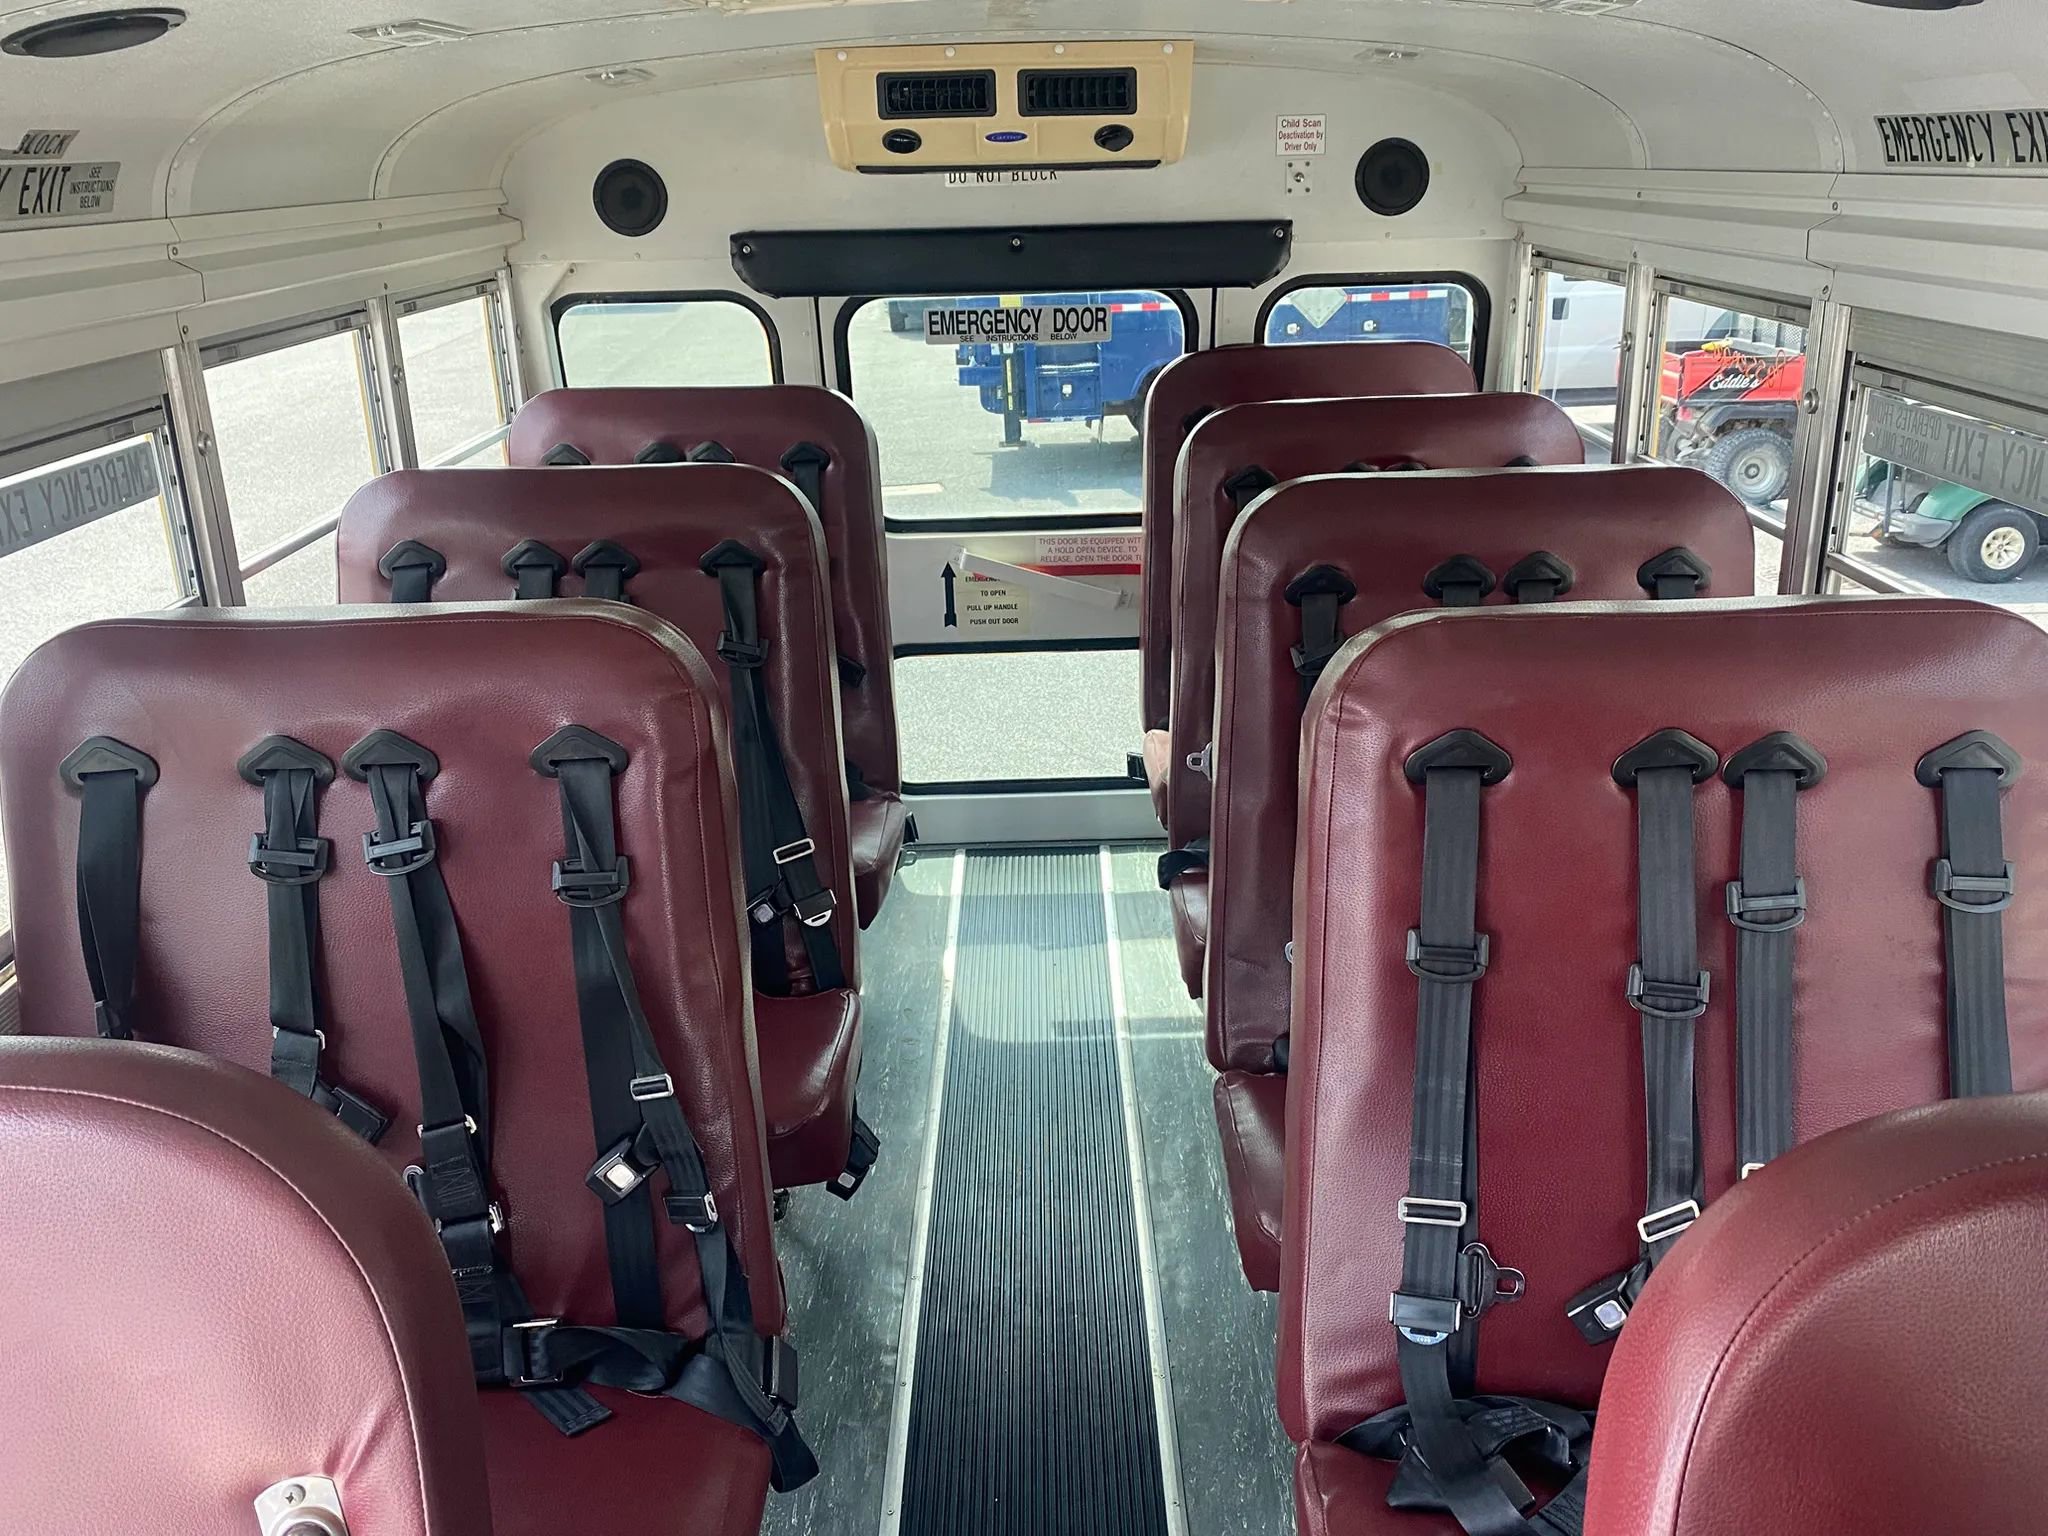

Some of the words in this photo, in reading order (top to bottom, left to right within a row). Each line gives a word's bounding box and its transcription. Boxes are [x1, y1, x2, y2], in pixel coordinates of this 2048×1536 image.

[1281, 119, 1300, 128] Child
[1302, 118, 1321, 128] Scan
[1278, 130, 1315, 140] Deactivation
[1316, 130, 1323, 141] by
[1877, 113, 1995, 163] EMERGENCY
[12, 133, 72, 155] BLOCK
[1284, 142, 1302, 151] Driver
[1303, 141, 1318, 152] Only
[88, 166, 102, 179] SEE
[949, 172, 967, 184] DO
[1011, 169, 1058, 182] BLOCK
[18, 166, 71, 215] EXIT
[69, 179, 115, 195] INSTRUCTIONS
[79, 195, 101, 209] BELOW
[928, 308, 1042, 336] EMERGENCY
[1053, 306, 1107, 333] DOOR
[960, 335, 974, 343] SEE
[986, 333, 1039, 342] INSTRUCTIONS
[1050, 332, 1078, 341] BELOW
[1709, 373, 1761, 391] Eddie's
[1057, 537, 1078, 545] DOOR
[1090, 536, 1125, 544] EQUIPPED
[1055, 546, 1075, 554] HOLD
[1076, 545, 1096, 553] OPEN
[1074, 554, 1095, 562] OPEN
[980, 589, 989, 597] TO
[990, 589, 1007, 597] OPEN
[994, 603, 1018, 611] HANDLE
[969, 618, 987, 626] PUSH
[1002, 617, 1019, 625] DOOR
